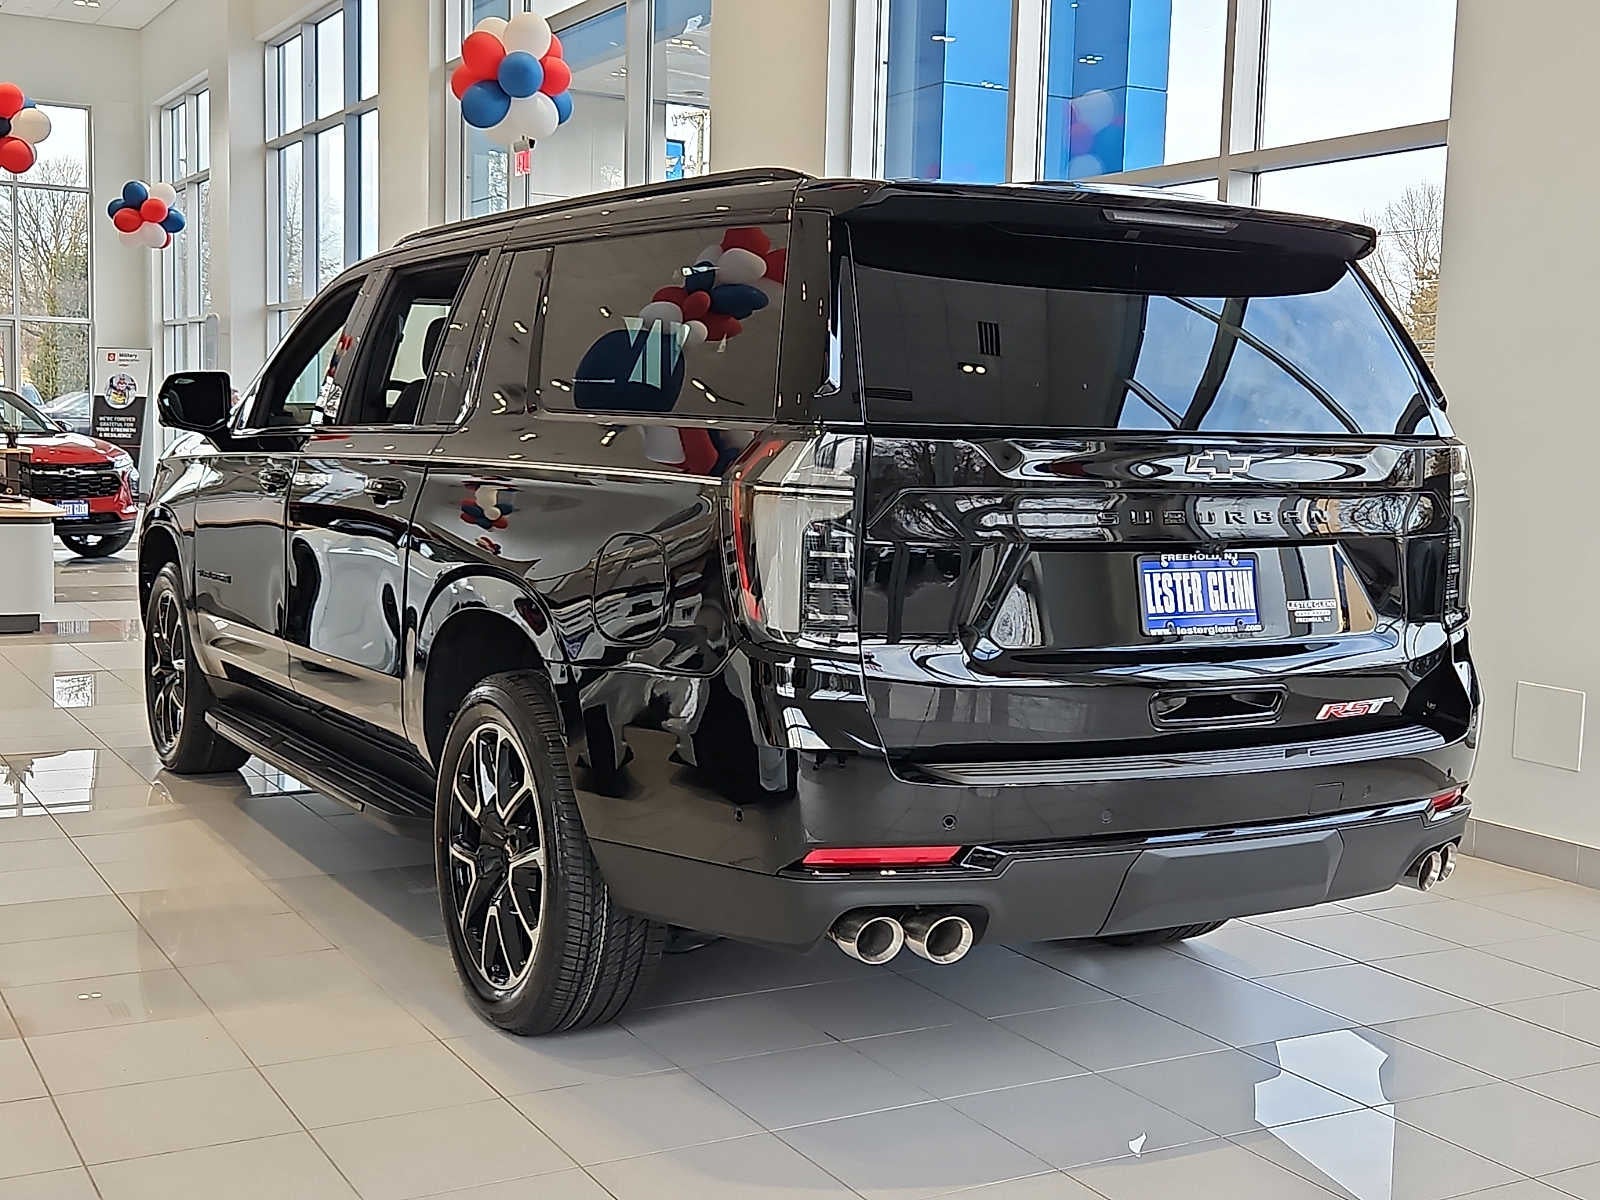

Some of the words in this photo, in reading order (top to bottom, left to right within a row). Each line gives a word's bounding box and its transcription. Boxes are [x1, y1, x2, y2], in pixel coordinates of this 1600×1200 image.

[1097, 510, 1327, 525] SUBURBAN
[1224, 552, 1238, 560] NJ
[1144, 571, 1205, 614] LESTER
[1206, 570, 1256, 612] GLENN
[1315, 696, 1394, 720] RST
